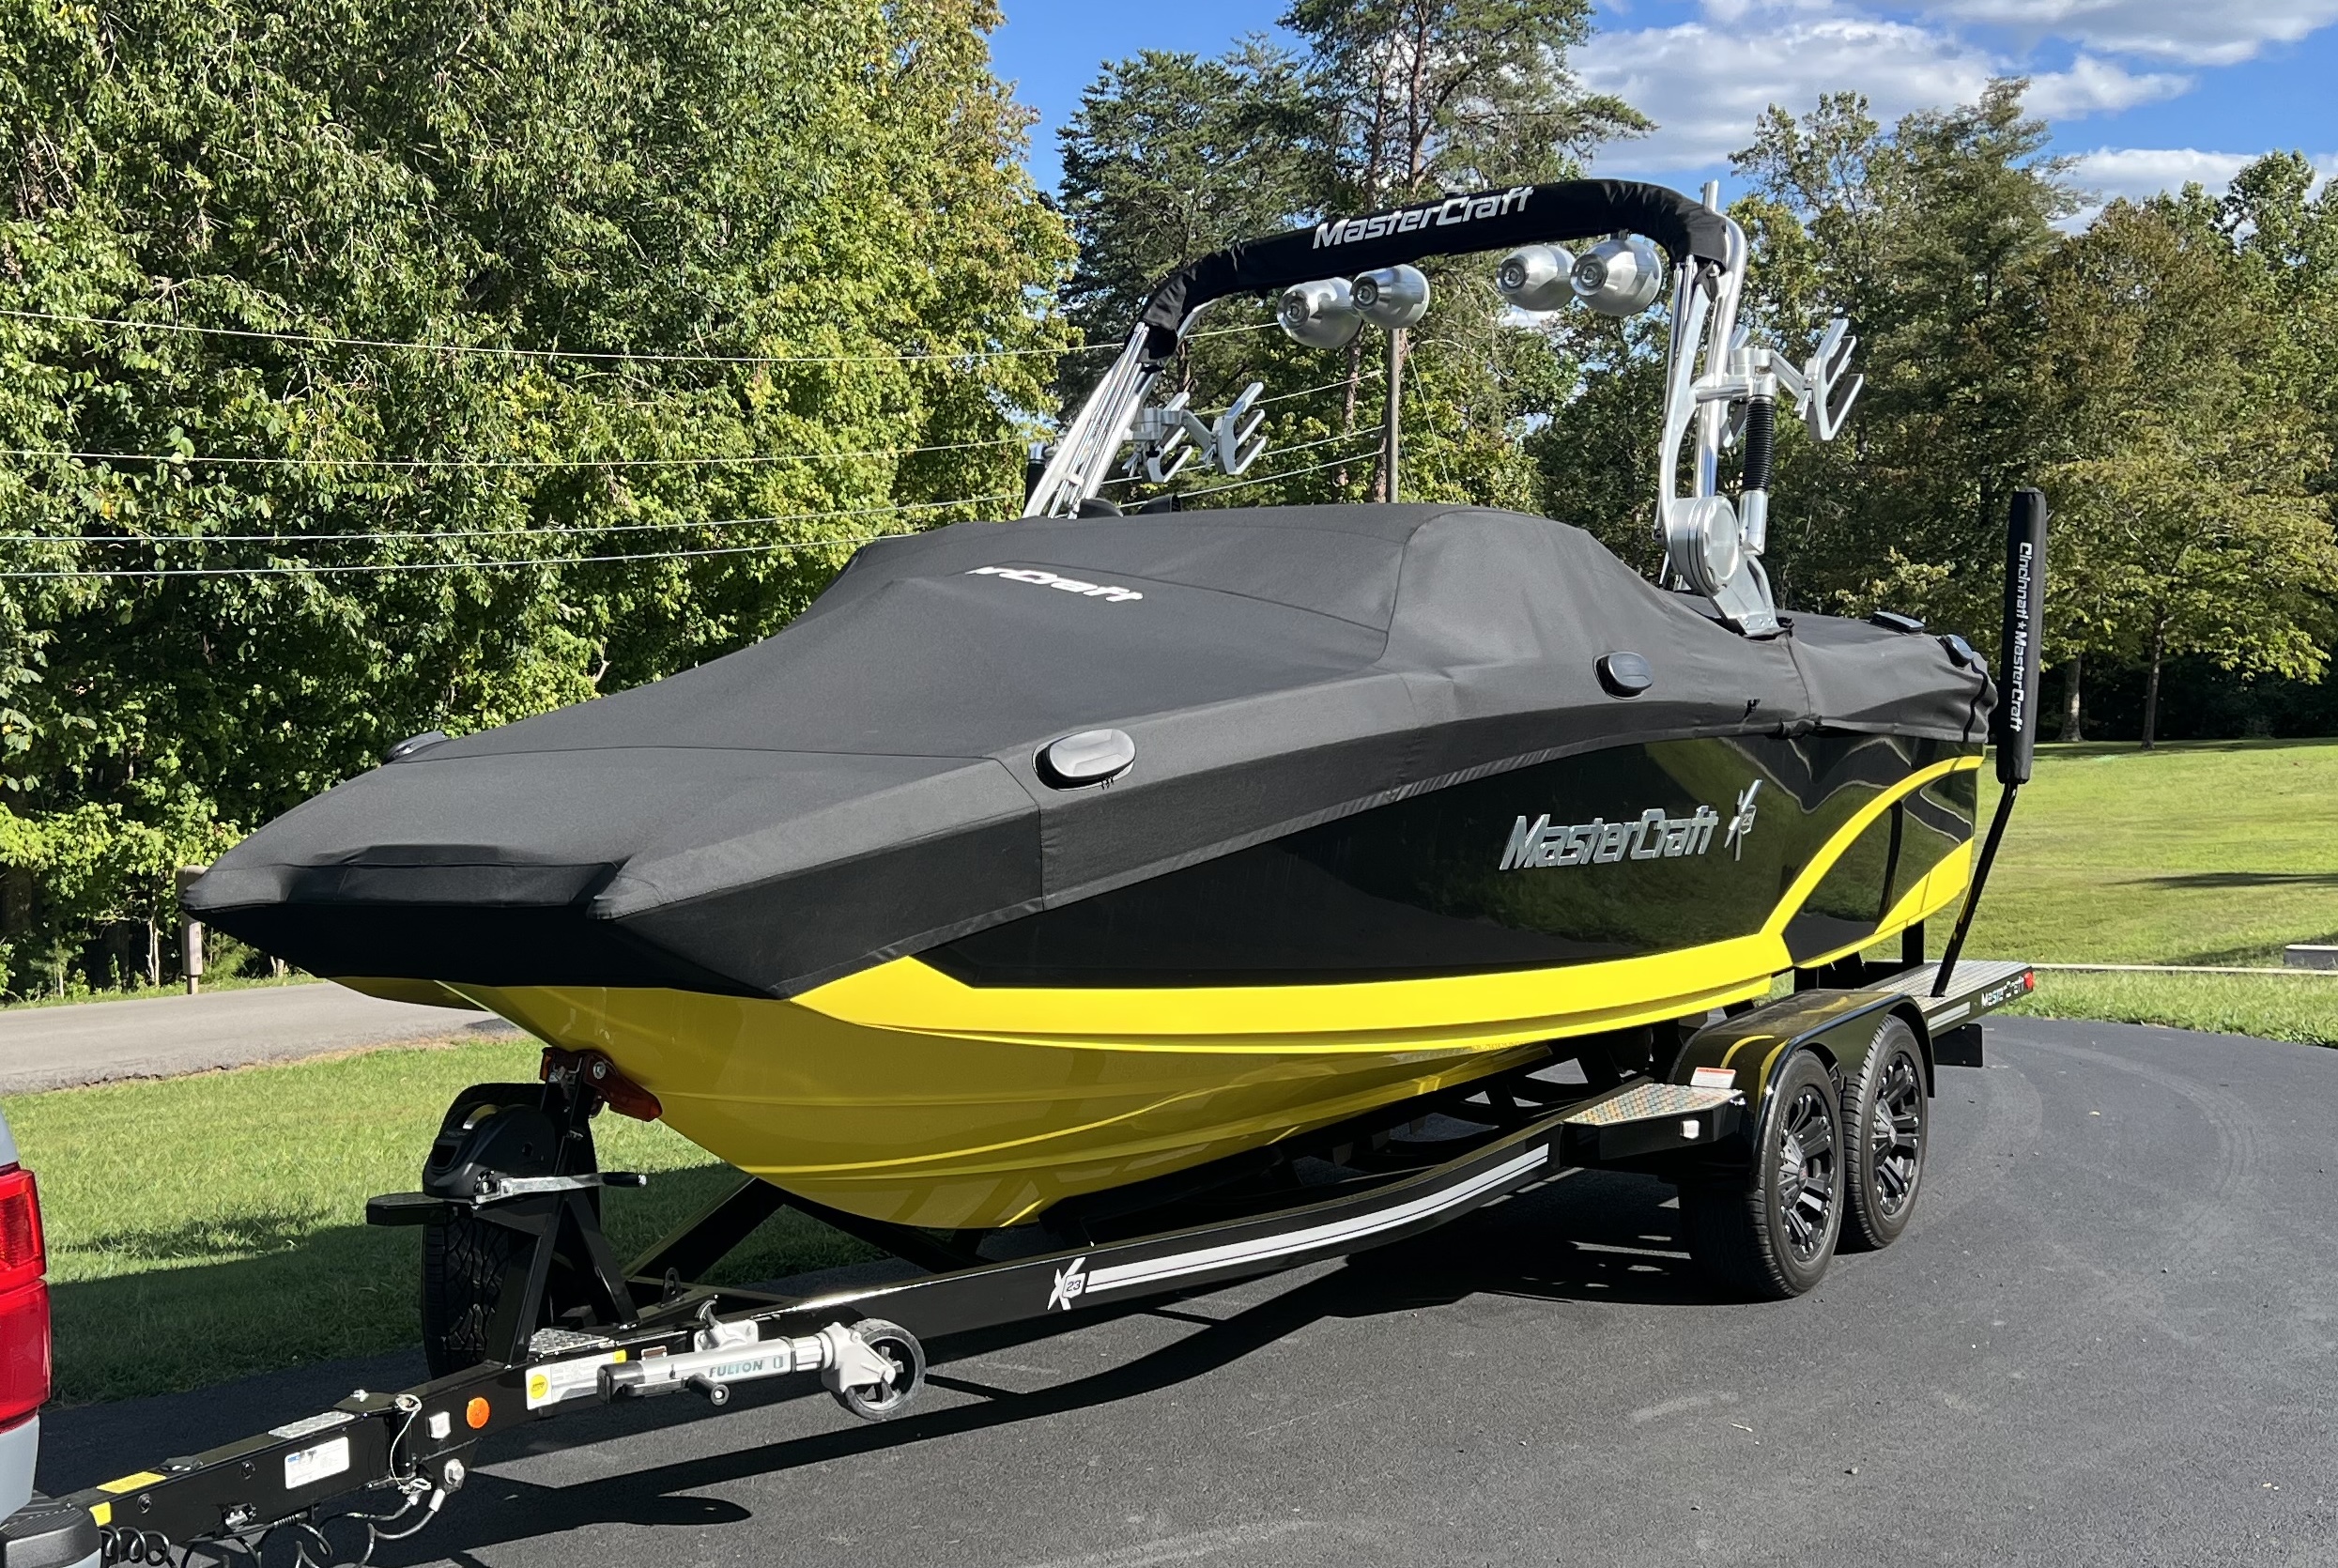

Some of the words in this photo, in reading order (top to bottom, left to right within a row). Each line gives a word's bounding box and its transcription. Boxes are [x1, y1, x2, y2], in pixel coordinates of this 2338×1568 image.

[1313, 186, 1534, 249] MasterCraft
[965, 566, 1144, 602] rCraft
[2016, 542, 2033, 620] Cincinnati
[2009, 630, 2028, 732] MasterCraft
[1499, 805, 1719, 871] MasterCraft
[709, 1359, 764, 1378] FULTON
